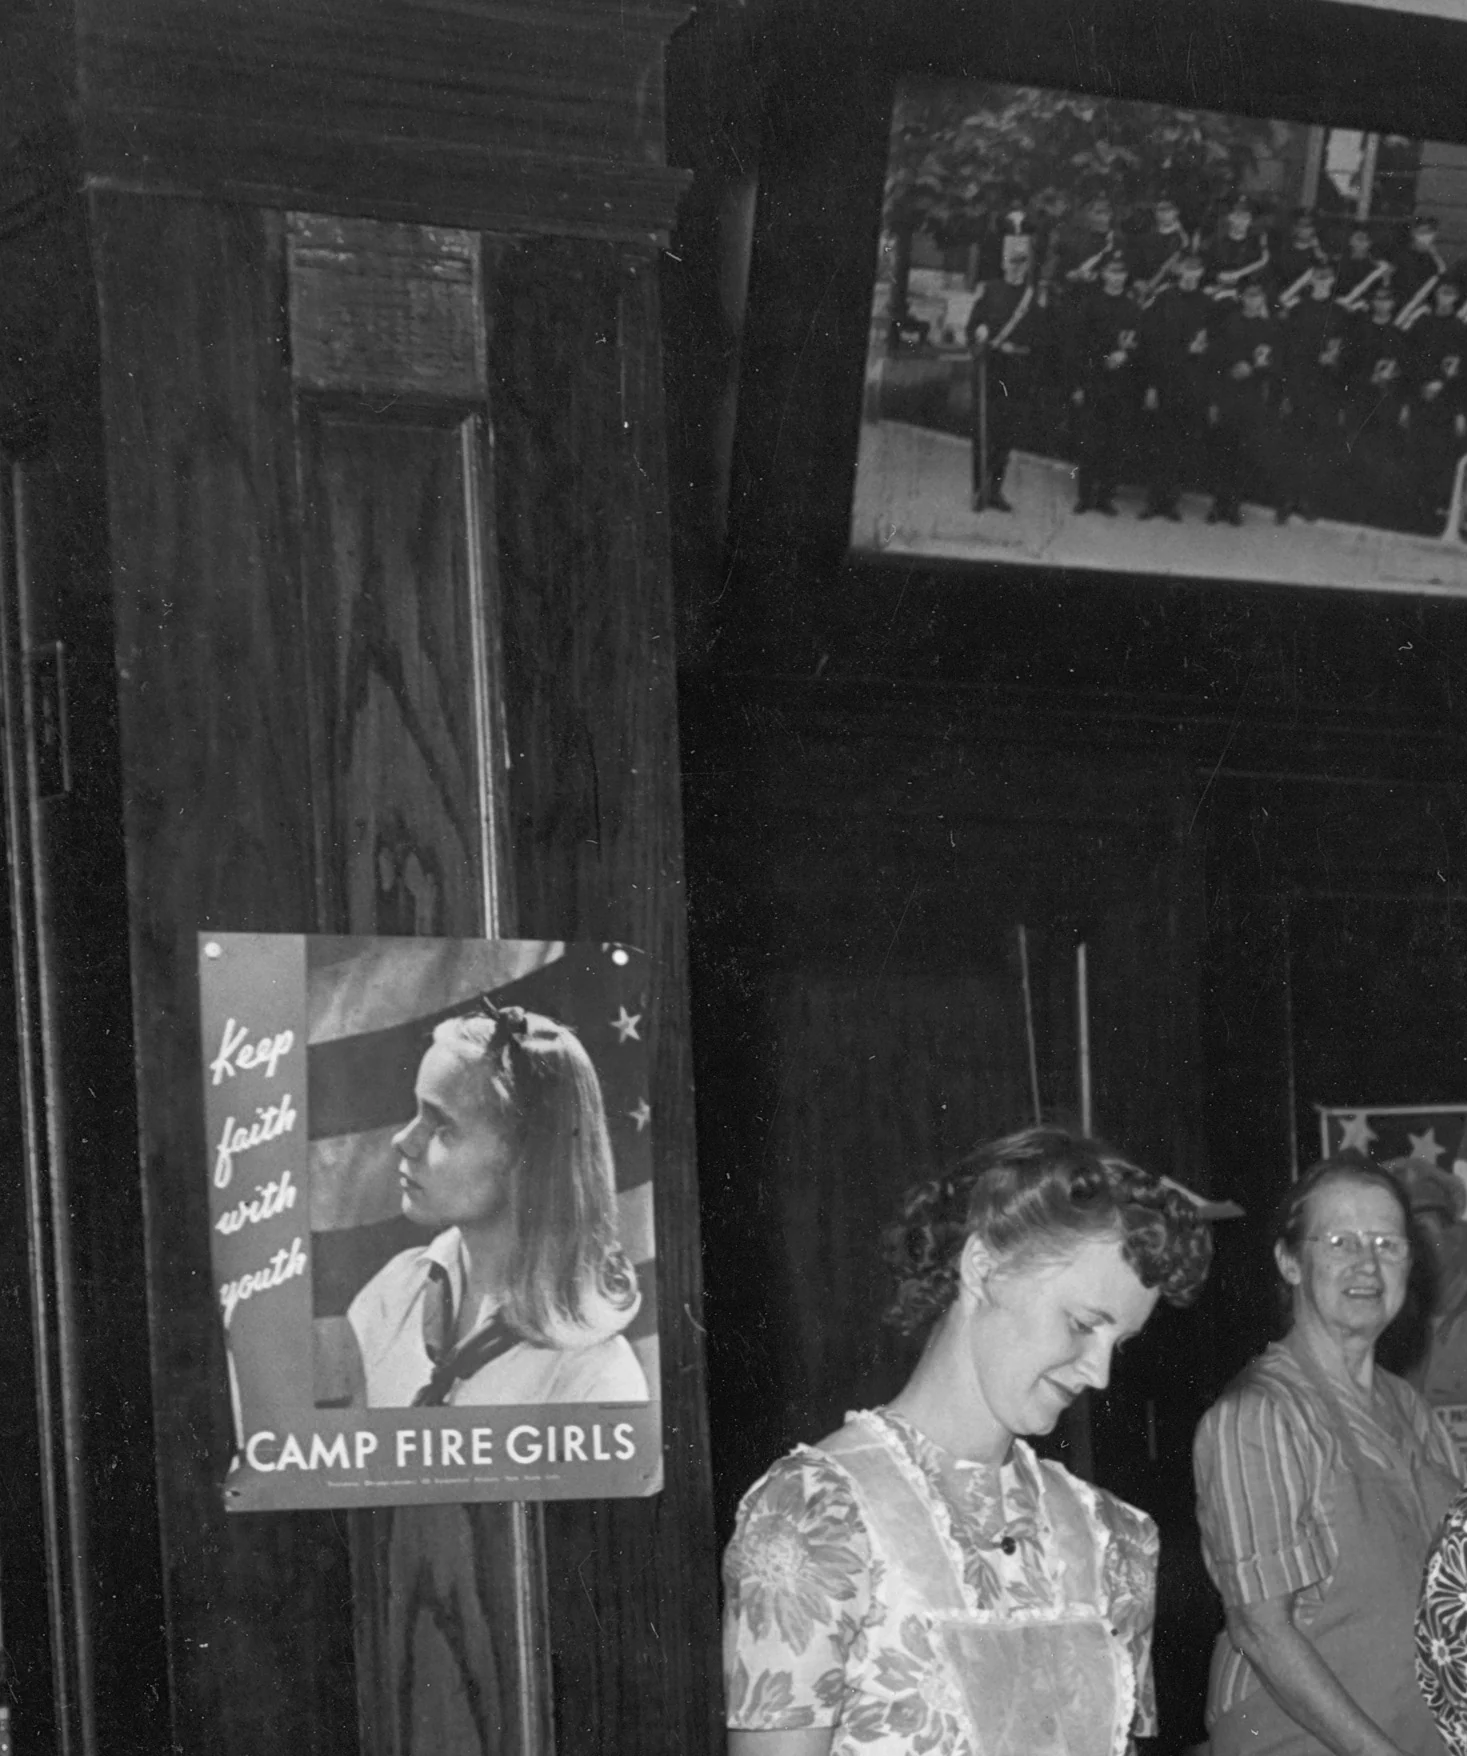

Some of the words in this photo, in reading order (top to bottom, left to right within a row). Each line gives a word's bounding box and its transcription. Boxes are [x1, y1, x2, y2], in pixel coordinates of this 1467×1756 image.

[209, 1017, 294, 1086] Keep
[214, 1093, 297, 1188] faith
[215, 1171, 297, 1235] with
[219, 1237, 307, 1330] youth
[245, 1431, 378, 1472] CAMP
[396, 1427, 493, 1467] FIRE
[506, 1423, 635, 1464] GIRLS
